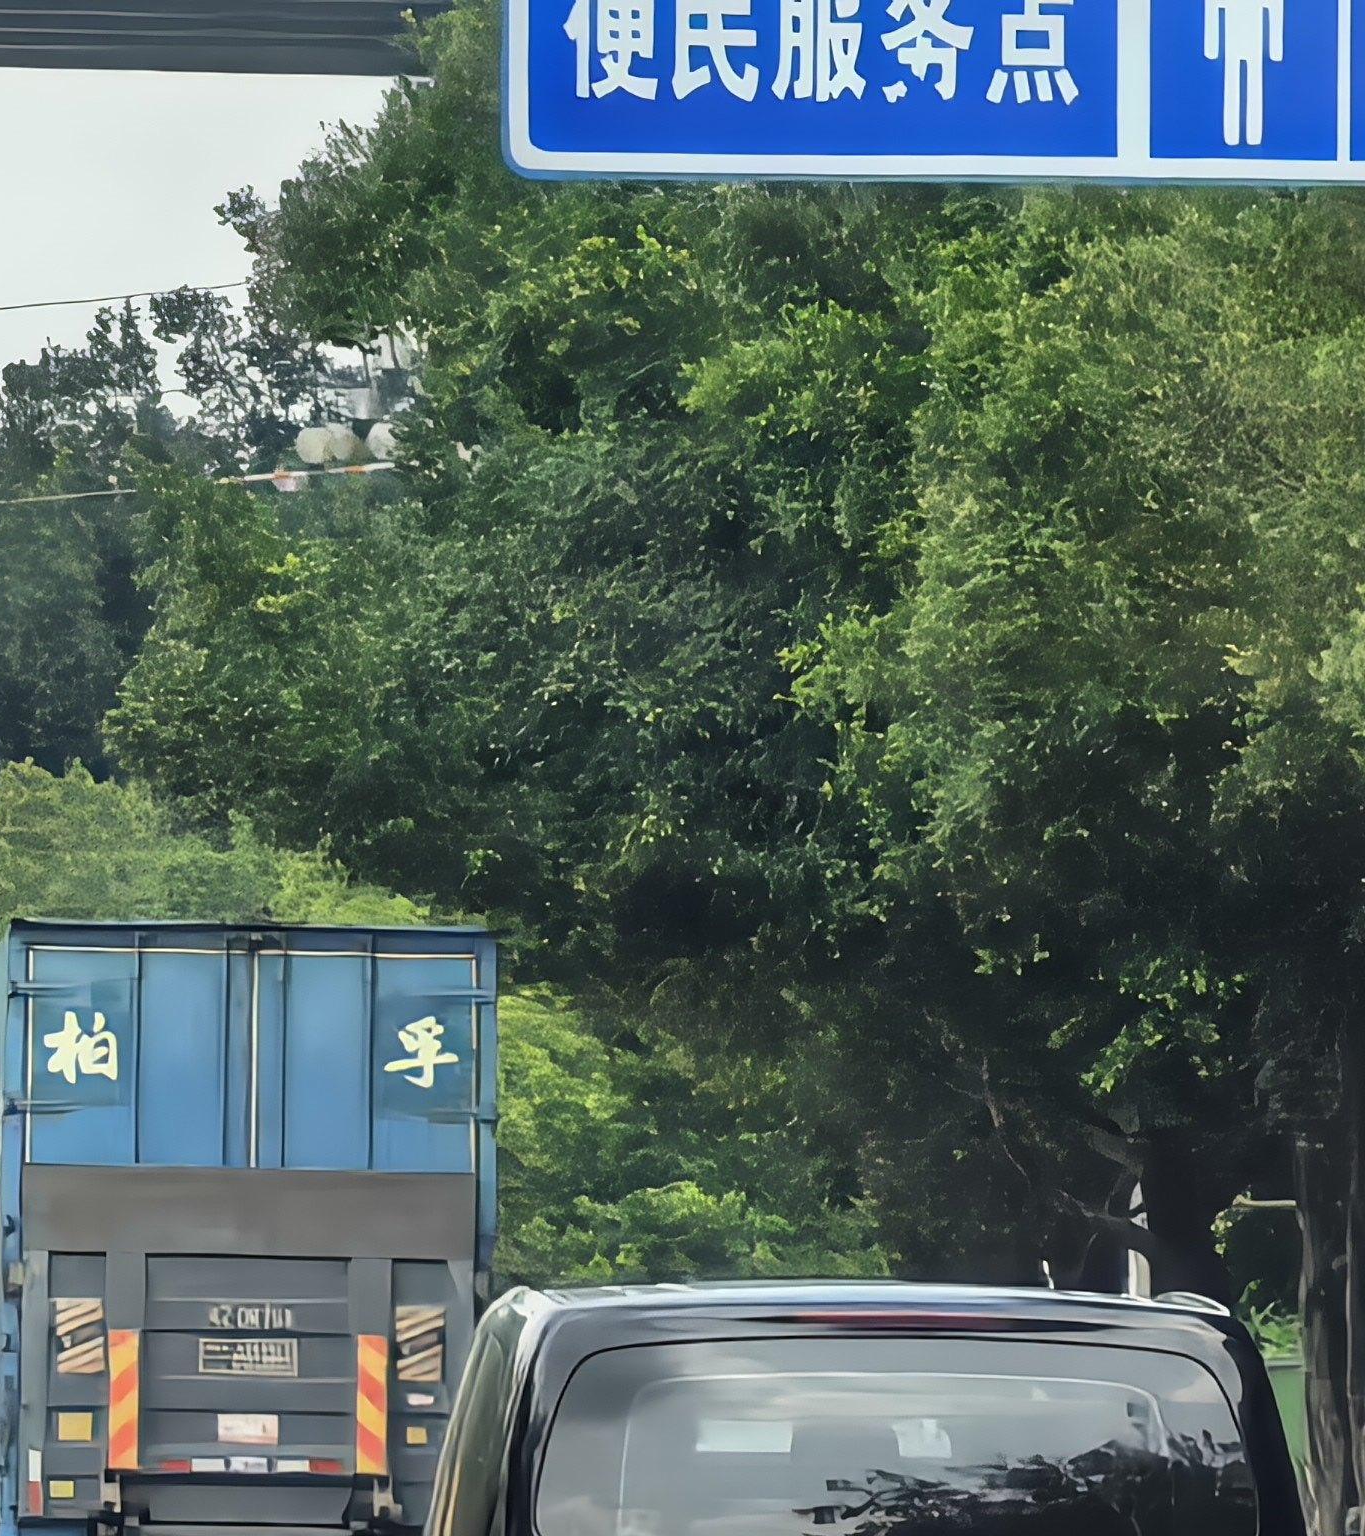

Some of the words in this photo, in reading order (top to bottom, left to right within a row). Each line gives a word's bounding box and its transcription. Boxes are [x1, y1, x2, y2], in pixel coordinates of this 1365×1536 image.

[563, 0, 1080, 106] 便民服务点
[43, 1010, 119, 1085] 柏
